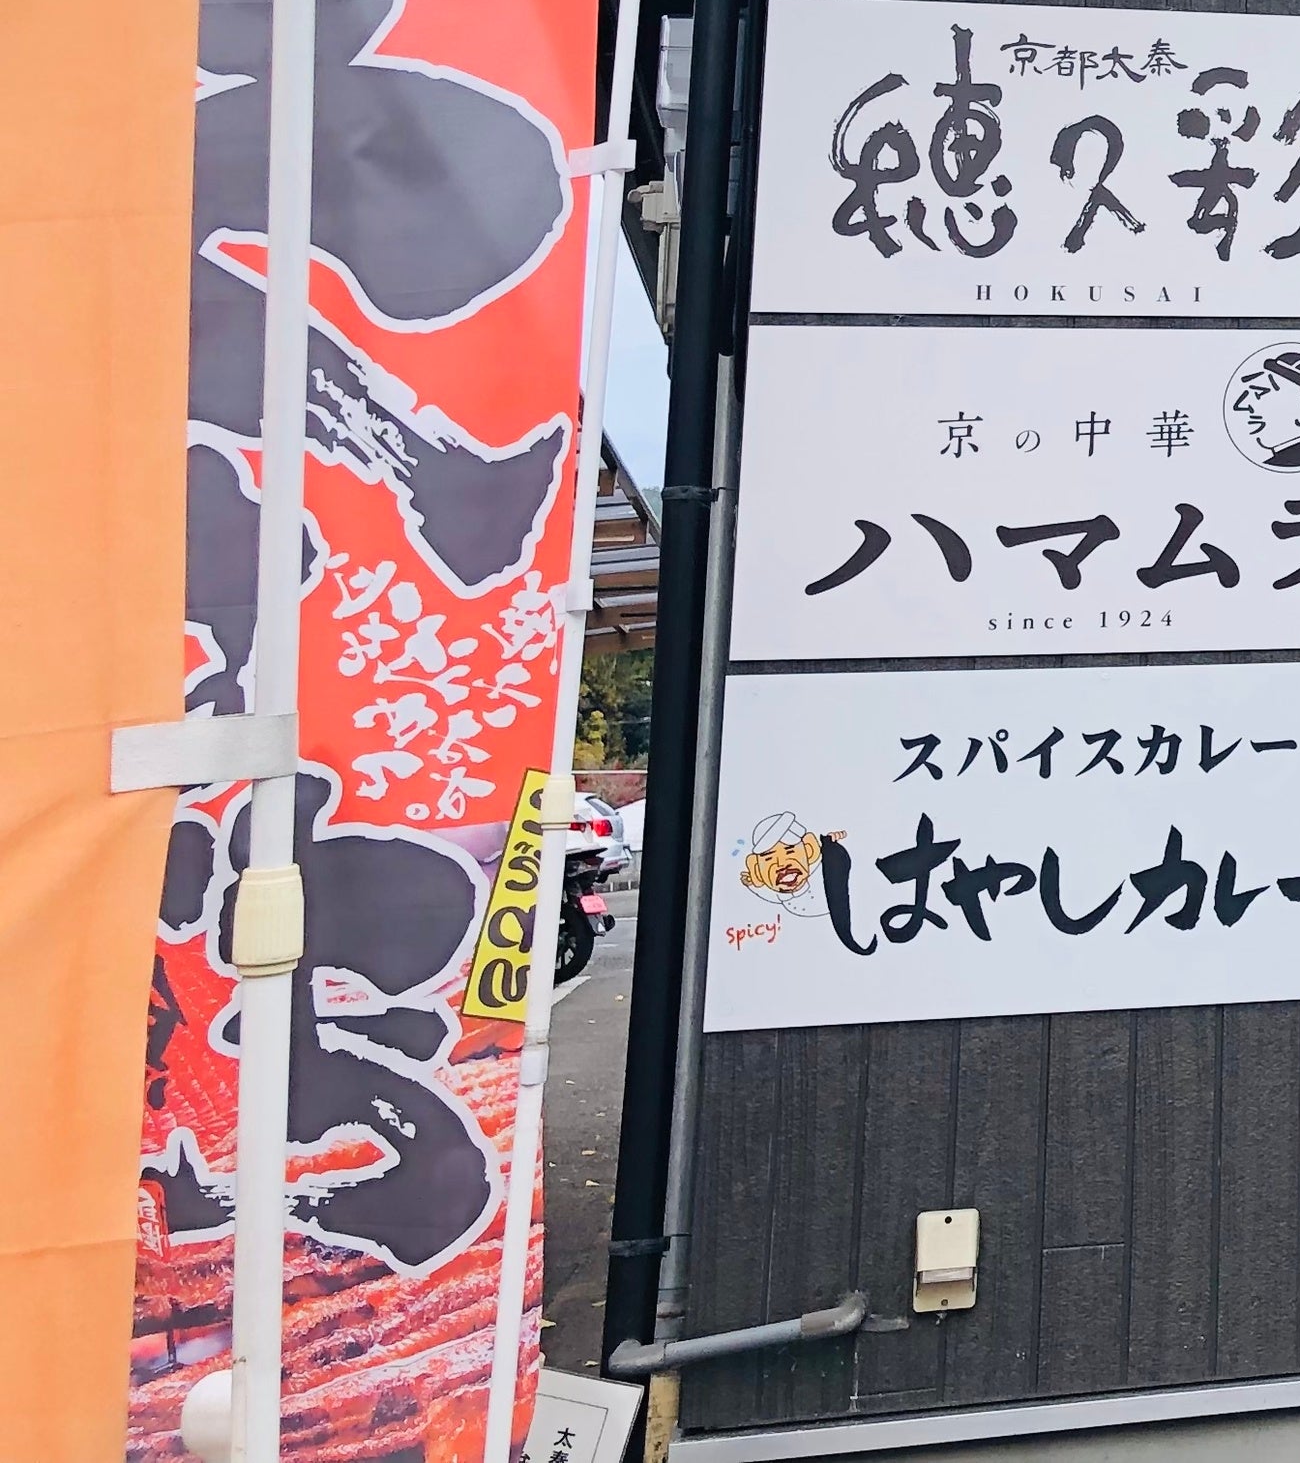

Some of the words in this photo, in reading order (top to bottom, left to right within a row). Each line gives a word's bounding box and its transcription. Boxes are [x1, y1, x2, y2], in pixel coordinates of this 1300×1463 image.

[1000, 32, 1189, 90] 京都太秦
[976, 284, 1203, 303] HOKUSAI
[937, 409, 1195, 458] 京の中華
[988, 611, 1076, 631] since
[1099, 608, 1176, 628] 1924
[892, 724, 1298, 783] スパイスカレー
